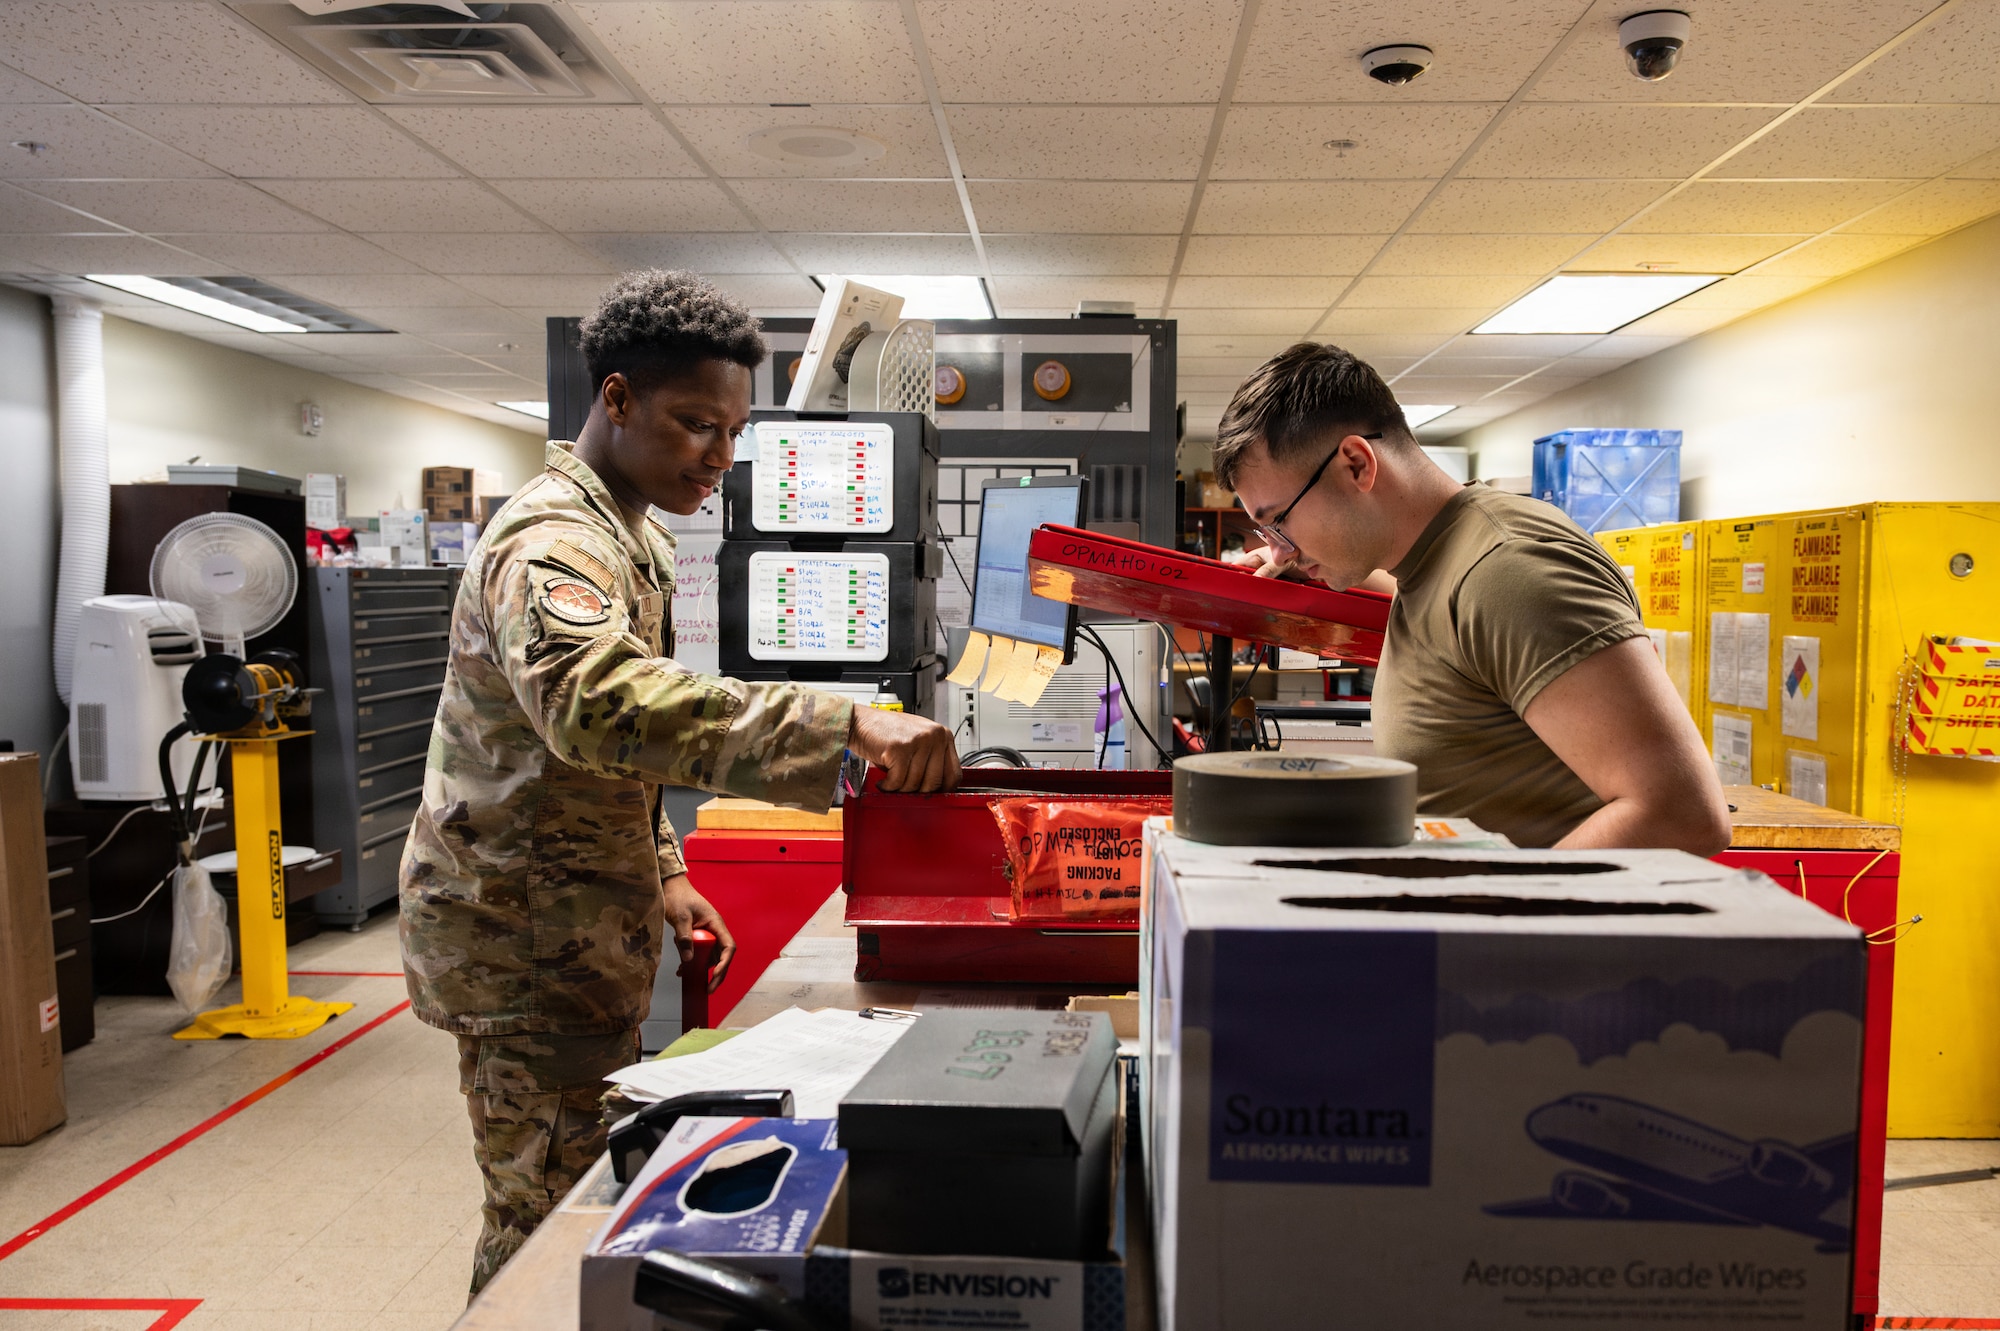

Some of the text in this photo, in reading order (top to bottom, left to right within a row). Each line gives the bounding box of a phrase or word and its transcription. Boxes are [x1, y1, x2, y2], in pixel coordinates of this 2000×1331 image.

[1793, 534, 1841, 557] FLAMMABLE
[1792, 565, 1840, 586] INFLAMABLE
[1792, 595, 1838, 615] INFLAMMABLE
[1059, 827, 1121, 841] ENCLOSED
[269, 834, 281, 917] CLAYTON
[1067, 865, 1121, 880] PACKING
[1221, 1142, 1411, 1166] AEROSPACE WIPES
[913, 1272, 1053, 1299] ENVISION
[1462, 1257, 1807, 1294] Aerospace Grade Wipes
